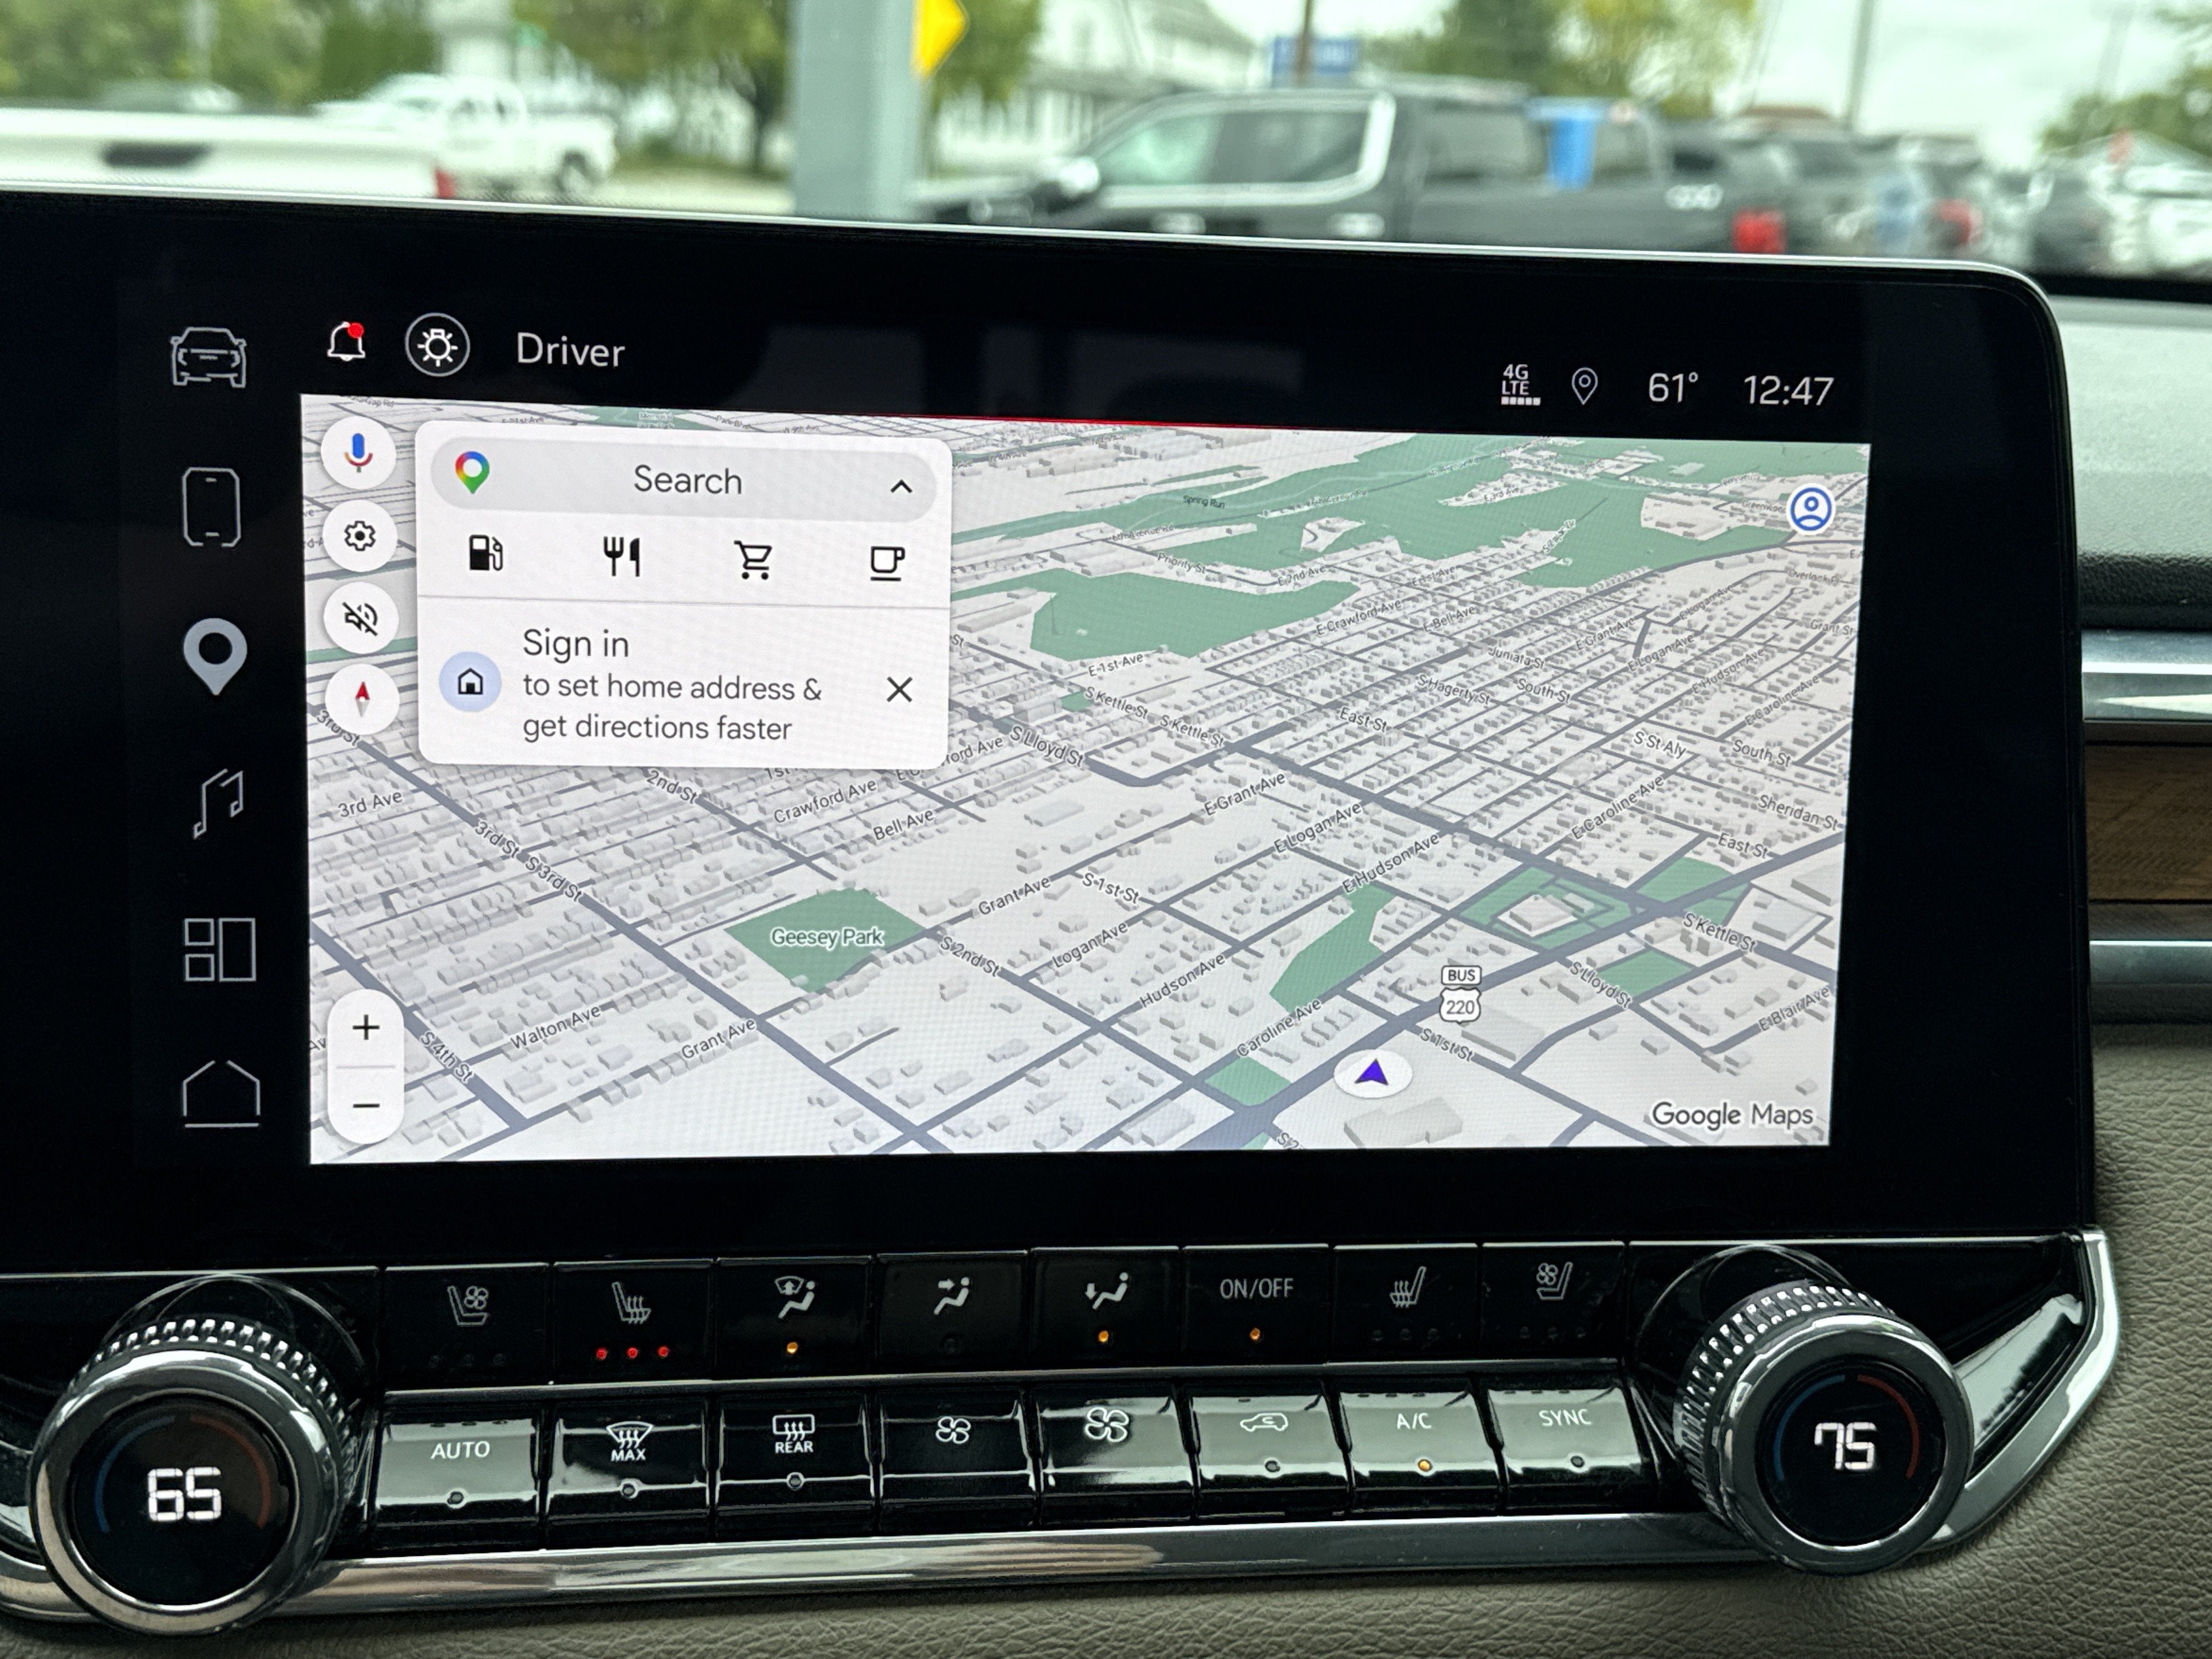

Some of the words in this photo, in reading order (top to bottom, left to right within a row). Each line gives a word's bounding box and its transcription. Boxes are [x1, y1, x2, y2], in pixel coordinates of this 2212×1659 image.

[517, 332, 625, 367] Driver
[1503, 364, 1528, 380] 4G
[1649, 372, 1699, 403] 61°
[1502, 381, 1529, 396] LTE
[1743, 375, 1835, 406] 12:47
[633, 463, 743, 495] Search
[1183, 495, 1209, 507] Spring
[1210, 498, 1226, 510] Run
[1195, 564, 1206, 574] St
[1277, 577, 1285, 586] E
[1308, 566, 1327, 577] Ave
[1437, 566, 1456, 577] Ave
[1317, 624, 1326, 636] E
[1327, 607, 1379, 631] Crawford
[1380, 599, 1402, 613] Ave
[1434, 614, 1454, 629] Bell
[1456, 606, 1476, 619] Ave
[1810, 619, 1840, 634] Grant
[523, 628, 591, 664] Sign
[603, 629, 629, 658] in
[1576, 640, 1585, 651] E
[1585, 628, 1614, 647] Grant
[1614, 617, 1635, 631] Ave
[1088, 664, 1098, 678] E
[1098, 660, 1119, 675] 1st
[1120, 653, 1144, 669] Ave
[1532, 658, 1545, 669] St
[1627, 661, 1638, 673] E
[1638, 646, 1671, 668] Logan
[1673, 634, 1696, 650] Ave
[523, 673, 549, 697] to
[558, 675, 599, 698] set
[608, 674, 682, 699] home
[691, 675, 795, 701] address
[803, 678, 822, 701] &
[1691, 682, 1701, 695] E
[1701, 661, 1743, 688] Hudson
[1743, 648, 1765, 664] Ave
[1085, 686, 1095, 699] S
[1096, 692, 1135, 714] Kettle
[1135, 705, 1149, 720] St
[1418, 674, 1427, 686] S
[1428, 678, 1475, 704] Hagerty
[1476, 691, 1491, 706] St
[1516, 678, 1554, 697] South
[1556, 690, 1571, 704] St
[1745, 714, 1754, 726] E
[1755, 690, 1798, 719] Caroline
[1798, 675, 1820, 692] Ave
[523, 717, 567, 744] get
[575, 713, 709, 740] directions
[716, 715, 793, 742] faster
[1160, 715, 1170, 727] S
[1171, 720, 1210, 742] Kettle
[1210, 734, 1224, 748] St
[1339, 707, 1372, 729] East
[1373, 718, 1387, 733] St
[978, 737, 1004, 755] Ave
[1010, 726, 1022, 742] S
[1024, 730, 1066, 761] Lloyd
[1066, 749, 1084, 768] St
[1633, 731, 1644, 744] S
[1646, 735, 1662, 750] St
[1664, 741, 1688, 760] Aly
[1732, 740, 1772, 764] South
[1773, 751, 1792, 768] St
[646, 770, 679, 795] 2nd
[680, 785, 697, 804] St
[774, 788, 844, 823] Crawford
[848, 780, 878, 798] Ave
[1204, 802, 1216, 816] E
[1216, 785, 1259, 812] Grant
[1260, 774, 1286, 792] Ave
[338, 800, 367, 818] 3rd
[373, 791, 403, 809] Ave
[1571, 826, 1584, 840] E
[1584, 793, 1639, 834] Caroline
[1639, 776, 1665, 800] Ave
[1758, 795, 1820, 827] Sheridan
[1821, 815, 1840, 832] St
[475, 820, 503, 847] 3rd
[502, 839, 520, 859] St
[873, 820, 904, 841] Bell
[906, 810, 934, 830] Ave
[1274, 839, 1287, 854] E
[1289, 817, 1334, 849] Logan
[1334, 802, 1363, 823] Ave
[1718, 832, 1750, 855] East
[1751, 843, 1768, 859] St
[525, 856, 539, 871] S
[538, 865, 565, 890] 3rd
[565, 882, 583, 902] St
[1343, 879, 1356, 894] E
[1357, 850, 1413, 887] Hudson
[1413, 832, 1441, 854] Ave
[978, 888, 1020, 916] Grant
[1021, 878, 1051, 899] Ave
[1082, 872, 1095, 888] S
[1097, 877, 1122, 899] 1st
[1122, 887, 1141, 904] St
[772, 928, 837, 949] Geesey
[843, 927, 883, 945] Park
[1052, 936, 1099, 969] Logan
[1099, 921, 1129, 944] Ave
[1683, 913, 1695, 928] S
[1696, 917, 1739, 947] Kettle
[1740, 936, 1757, 953] St
[940, 936, 953, 951] S
[952, 941, 984, 967] 2nd
[983, 957, 1000, 977] St
[1140, 969, 1199, 1008] Hudson
[1198, 953, 1226, 977] Ave
[1448, 969, 1476, 982] BUS
[1570, 961, 1582, 976] S
[1580, 967, 1616, 1000] Lloyd
[1615, 990, 1632, 1008] St
[1446, 1000, 1475, 1016] 220
[1759, 1018, 1771, 1032] E
[1771, 1000, 1803, 1026] Blair
[1805, 986, 1831, 1008] Ave
[510, 1019, 567, 1050] Walton
[568, 1006, 602, 1026] Ave
[681, 1032, 725, 1059] Grant
[727, 1019, 757, 1040] Ave
[1236, 1017, 1294, 1058] Caroline
[1294, 998, 1322, 1024] Ave
[420, 1031, 435, 1047] S
[431, 1042, 456, 1069] 4th
[455, 1062, 475, 1083] St
[1419, 1028, 1432, 1043] S
[1432, 1034, 1459, 1056] 1st
[1457, 1046, 1474, 1063] St
[1652, 1102, 1741, 1131] Google
[1751, 1104, 1814, 1130] Maps
[1220, 1277, 1294, 1300] ON/OFF
[1396, 1412, 1432, 1431] A/C
[1538, 1408, 1592, 1426] SYNC
[430, 1441, 490, 1460] AUTO
[610, 1449, 647, 1462] MAX
[774, 1441, 814, 1454] REAR
[1814, 1421, 1877, 1471] 75
[147, 1466, 222, 1522] 65
